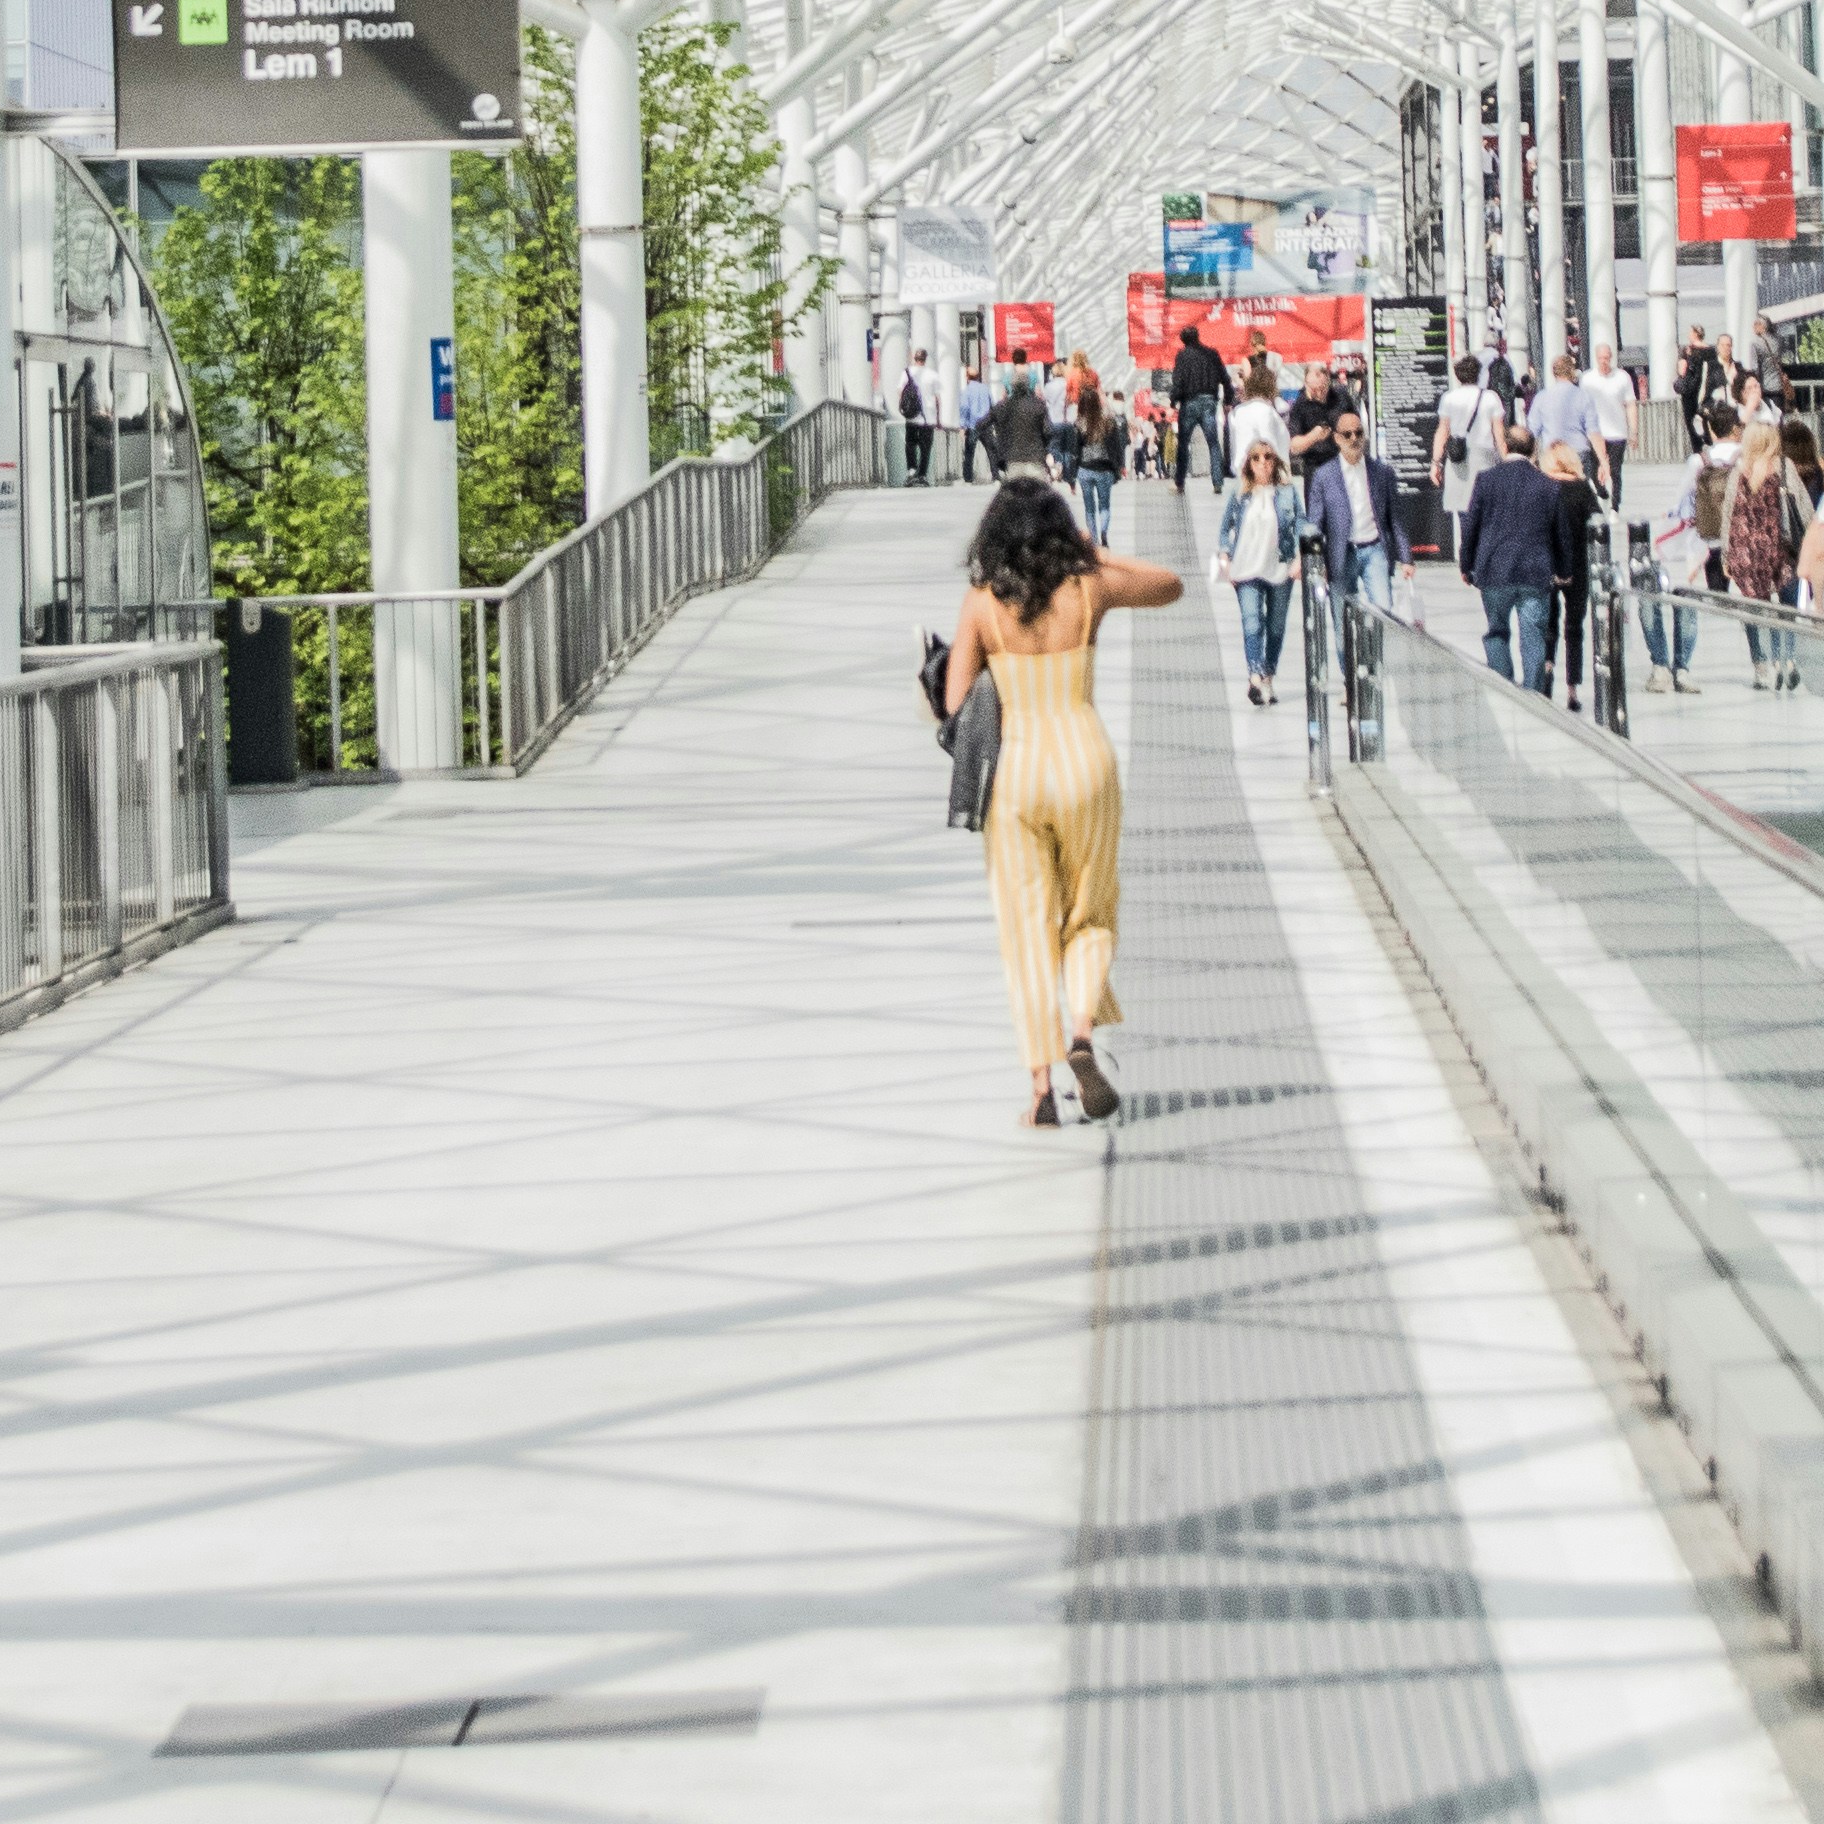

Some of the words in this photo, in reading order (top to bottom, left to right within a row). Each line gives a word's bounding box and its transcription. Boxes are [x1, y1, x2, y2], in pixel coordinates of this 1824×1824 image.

[245, 20, 339, 45] Meeting
[344, 19, 415, 41] Room
[244, 48, 317, 80] Lem
[326, 46, 342, 77] 1
[1275, 237, 1365, 252] INTEGRATA
[904, 263, 991, 278] GALLERIA
